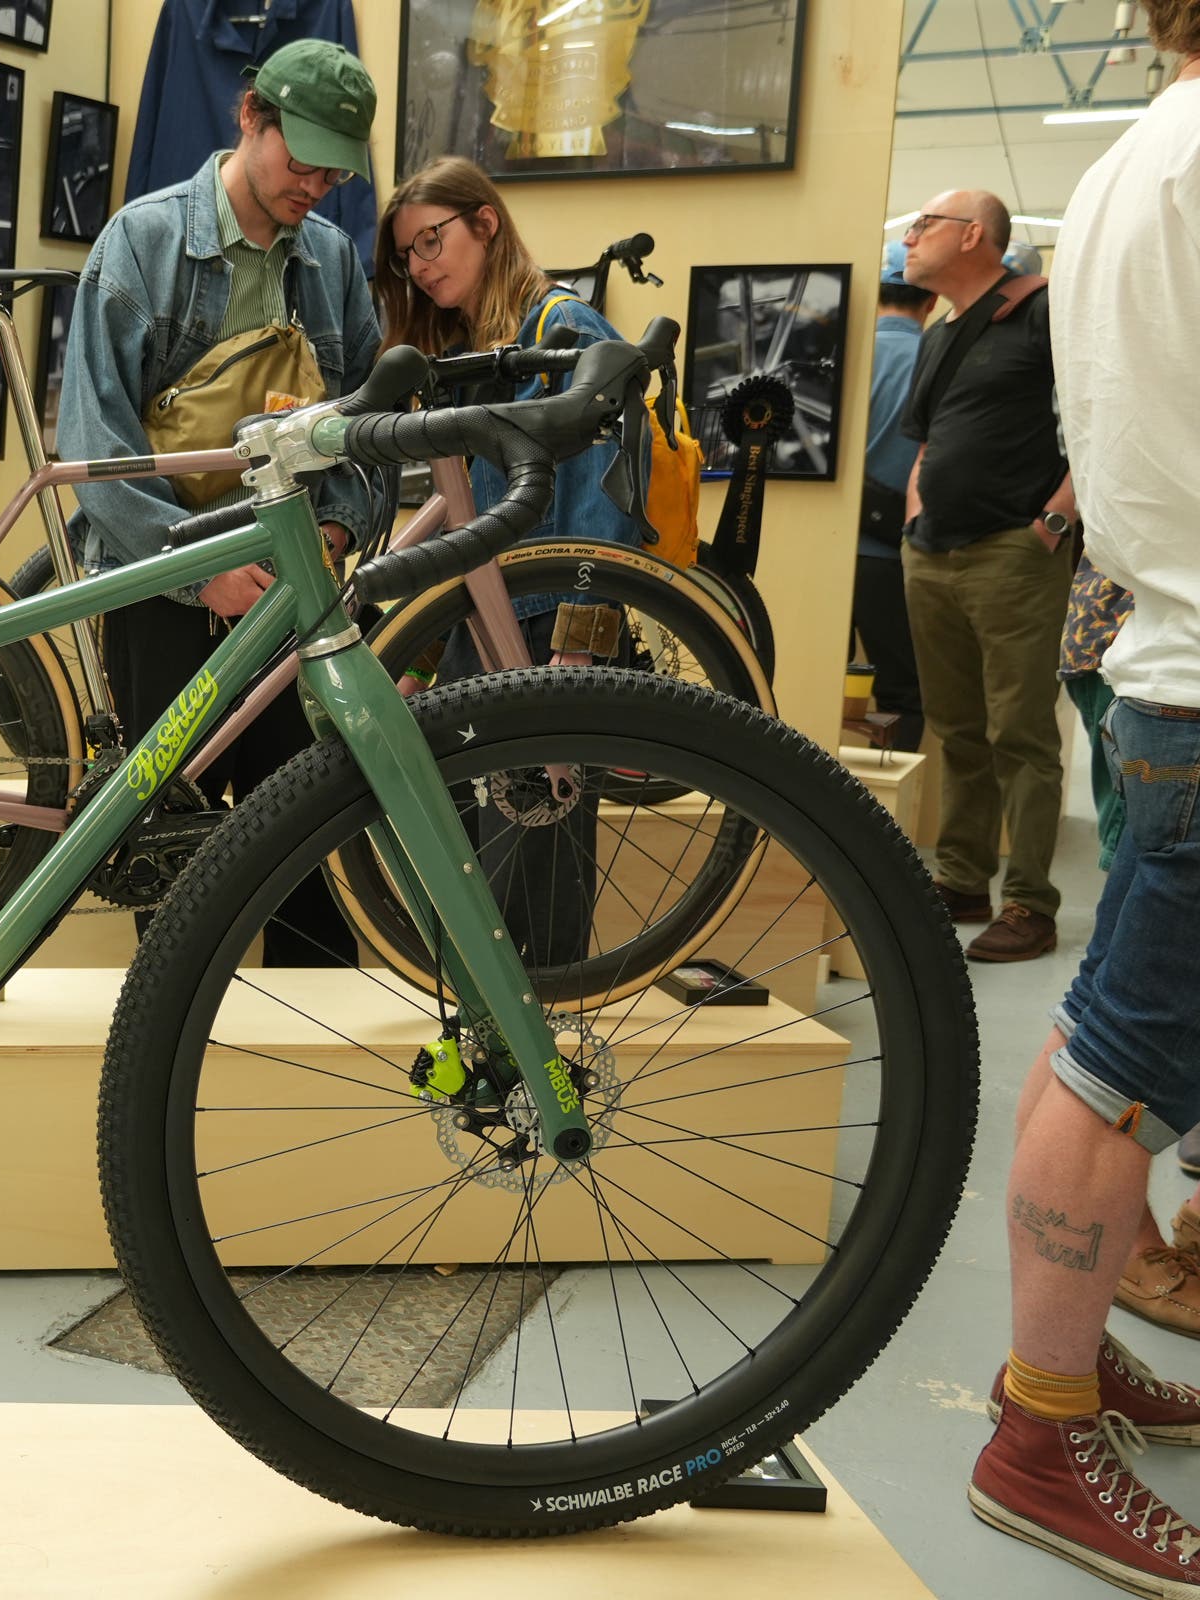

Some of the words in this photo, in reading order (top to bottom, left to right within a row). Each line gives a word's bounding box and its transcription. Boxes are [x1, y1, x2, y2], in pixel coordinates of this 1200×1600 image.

[747, 445, 761, 470] Best
[735, 473, 758, 544] Singlespeed
[534, 547, 571, 556] CORSA
[127, 669, 219, 801] Pashley
[137, 826, 212, 842] DURA-ACE
[725, 1440, 746, 1457] SPEED
[546, 1482, 635, 1512] SCHWALBE
[637, 1464, 683, 1495] RACE
[685, 1448, 722, 1477] PRO
[721, 1436, 739, 1451] RICK
[745, 1423, 758, 1435] TLR
